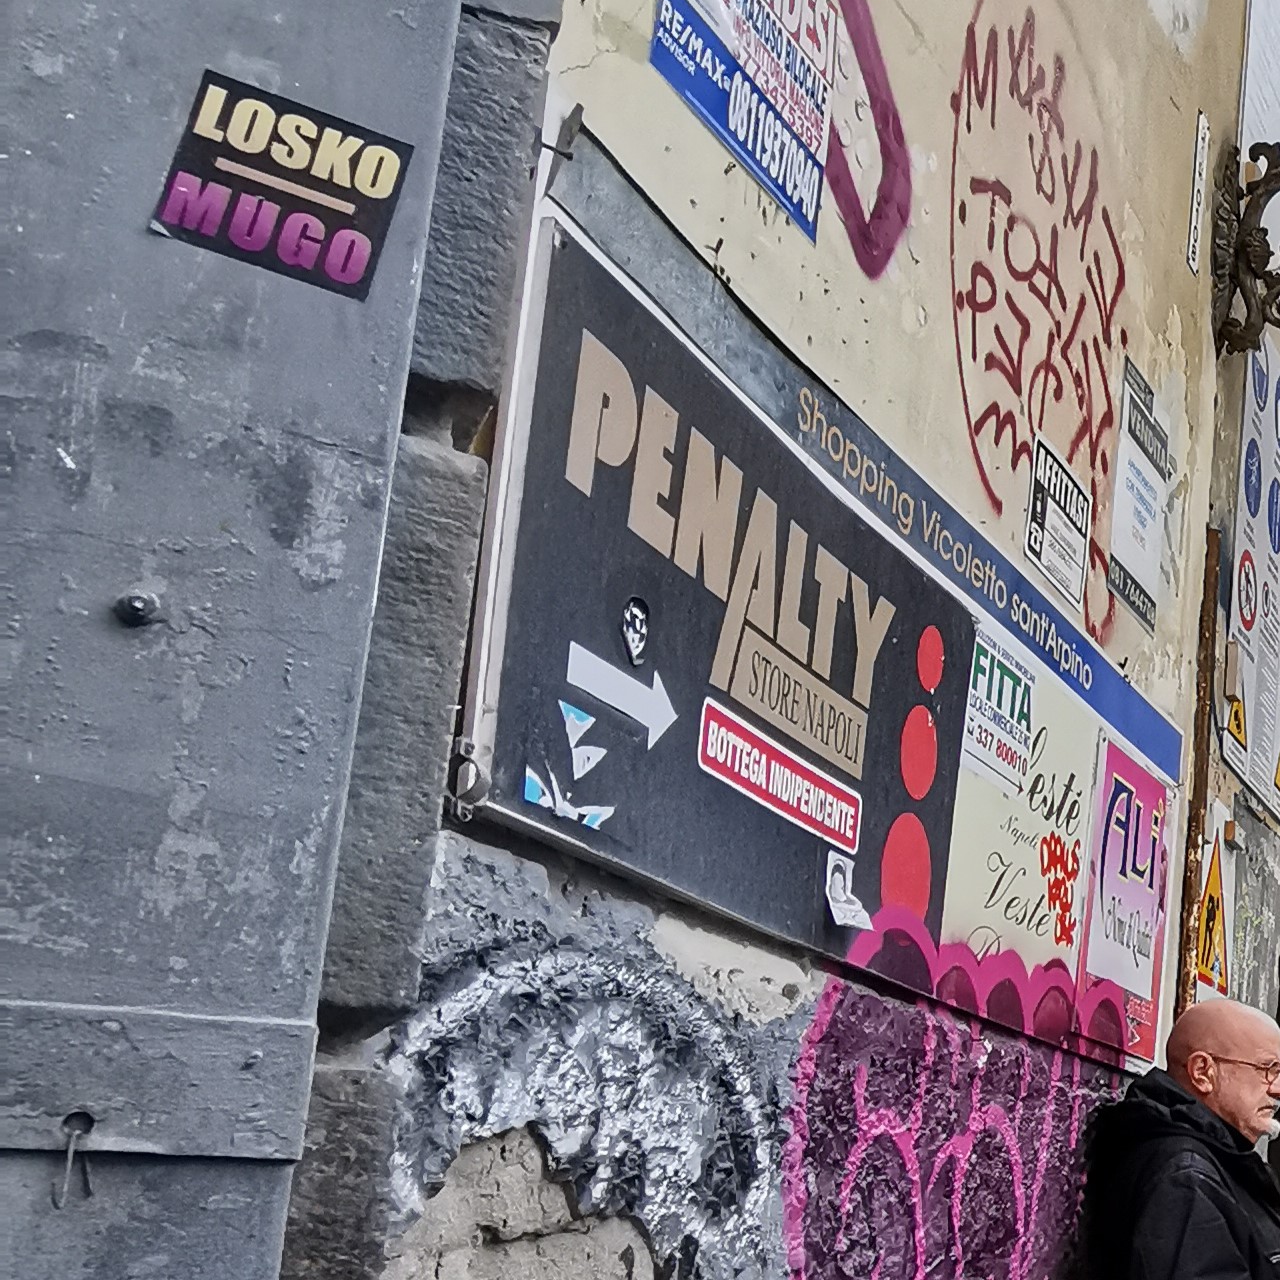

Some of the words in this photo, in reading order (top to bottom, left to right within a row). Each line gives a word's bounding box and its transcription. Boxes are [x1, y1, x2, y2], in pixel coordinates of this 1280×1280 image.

[656, 27, 696, 77] ADVISOR
[784, 35, 828, 117] BILOCALE
[191, 83, 401, 200] LOSKO
[160, 170, 373, 285] MUGO
[1129, 401, 1167, 472] VENDITA
[565, 328, 896, 709] PENALTY
[1036, 446, 1088, 535] AFFITTASI
[797, 387, 915, 536] Shopping
[920, 499, 1008, 610] Vicoletto
[1010, 592, 1093, 692] sant'Arpino
[748, 649, 802, 728] STORE
[802, 681, 863, 766] NAPOLI
[971, 641, 1032, 734] FITTA
[706, 719, 767, 791] BOTTEGA
[768, 758, 856, 840] INDIPENDENTE
[975, 724, 995, 753] 337
[1000, 813, 1040, 852] Napoli
[984, 851, 1053, 937] Veste
